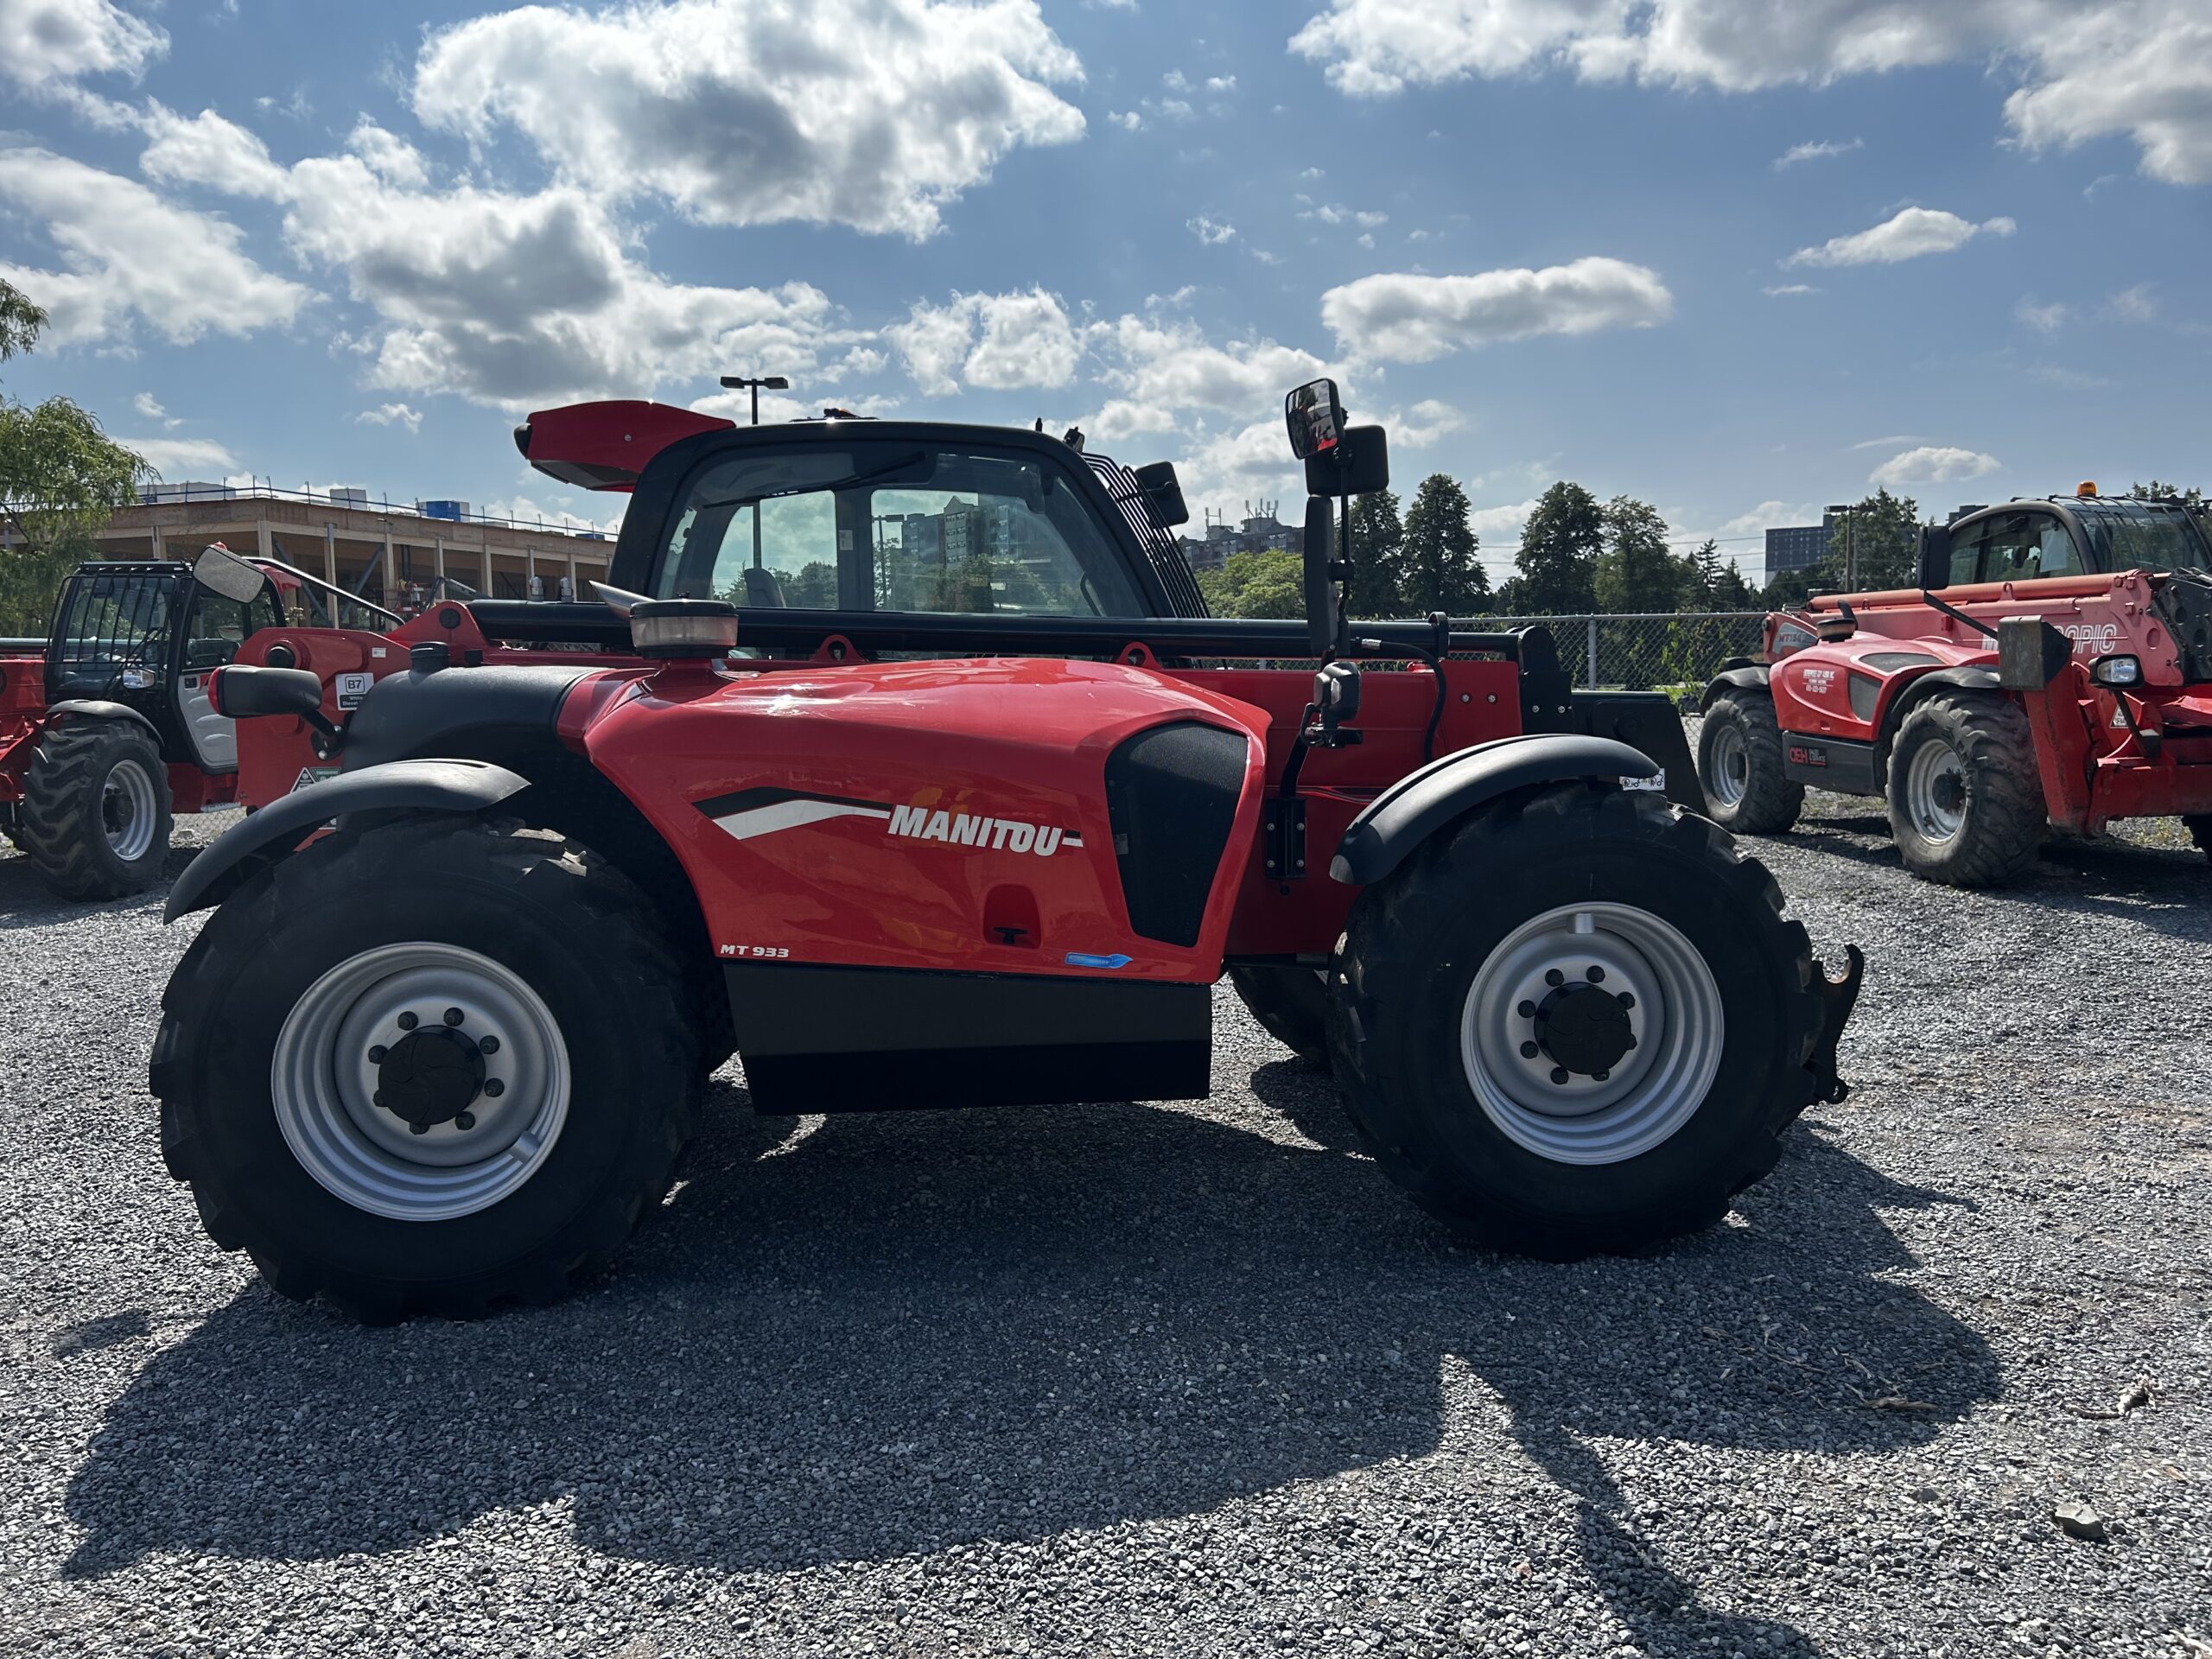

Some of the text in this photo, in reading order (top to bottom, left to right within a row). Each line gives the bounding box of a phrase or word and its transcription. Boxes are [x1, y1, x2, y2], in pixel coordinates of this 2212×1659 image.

[347, 679, 362, 690] B7
[887, 804, 1063, 856] MANITOU
[720, 944, 790, 958] MT 933
